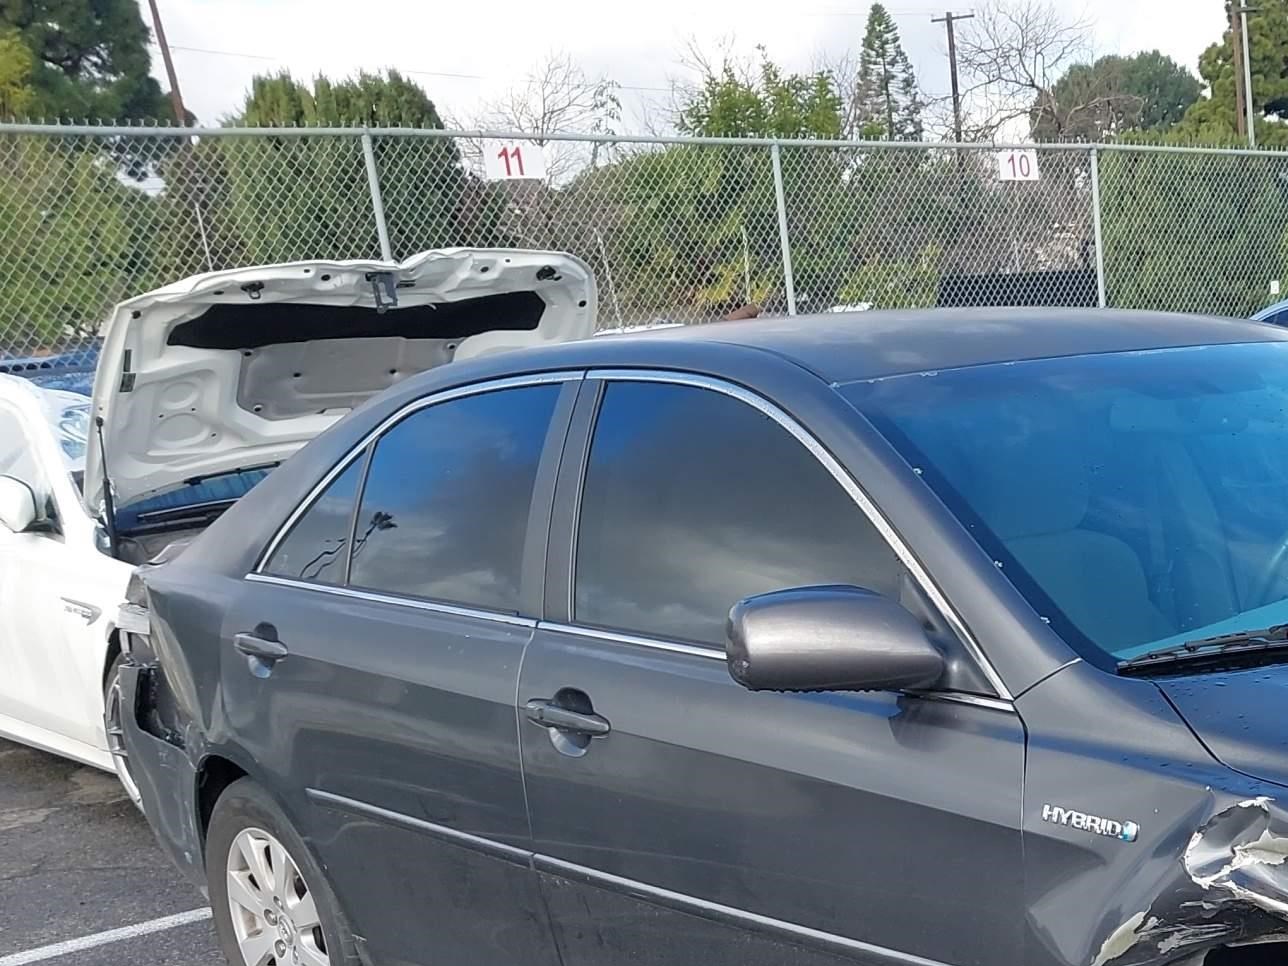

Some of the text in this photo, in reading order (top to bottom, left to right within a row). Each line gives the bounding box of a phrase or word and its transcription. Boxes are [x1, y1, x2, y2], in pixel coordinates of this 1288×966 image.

[497, 146, 525, 176] 11
[1007, 153, 1031, 178] 10
[1042, 804, 1122, 836] HYBRID
